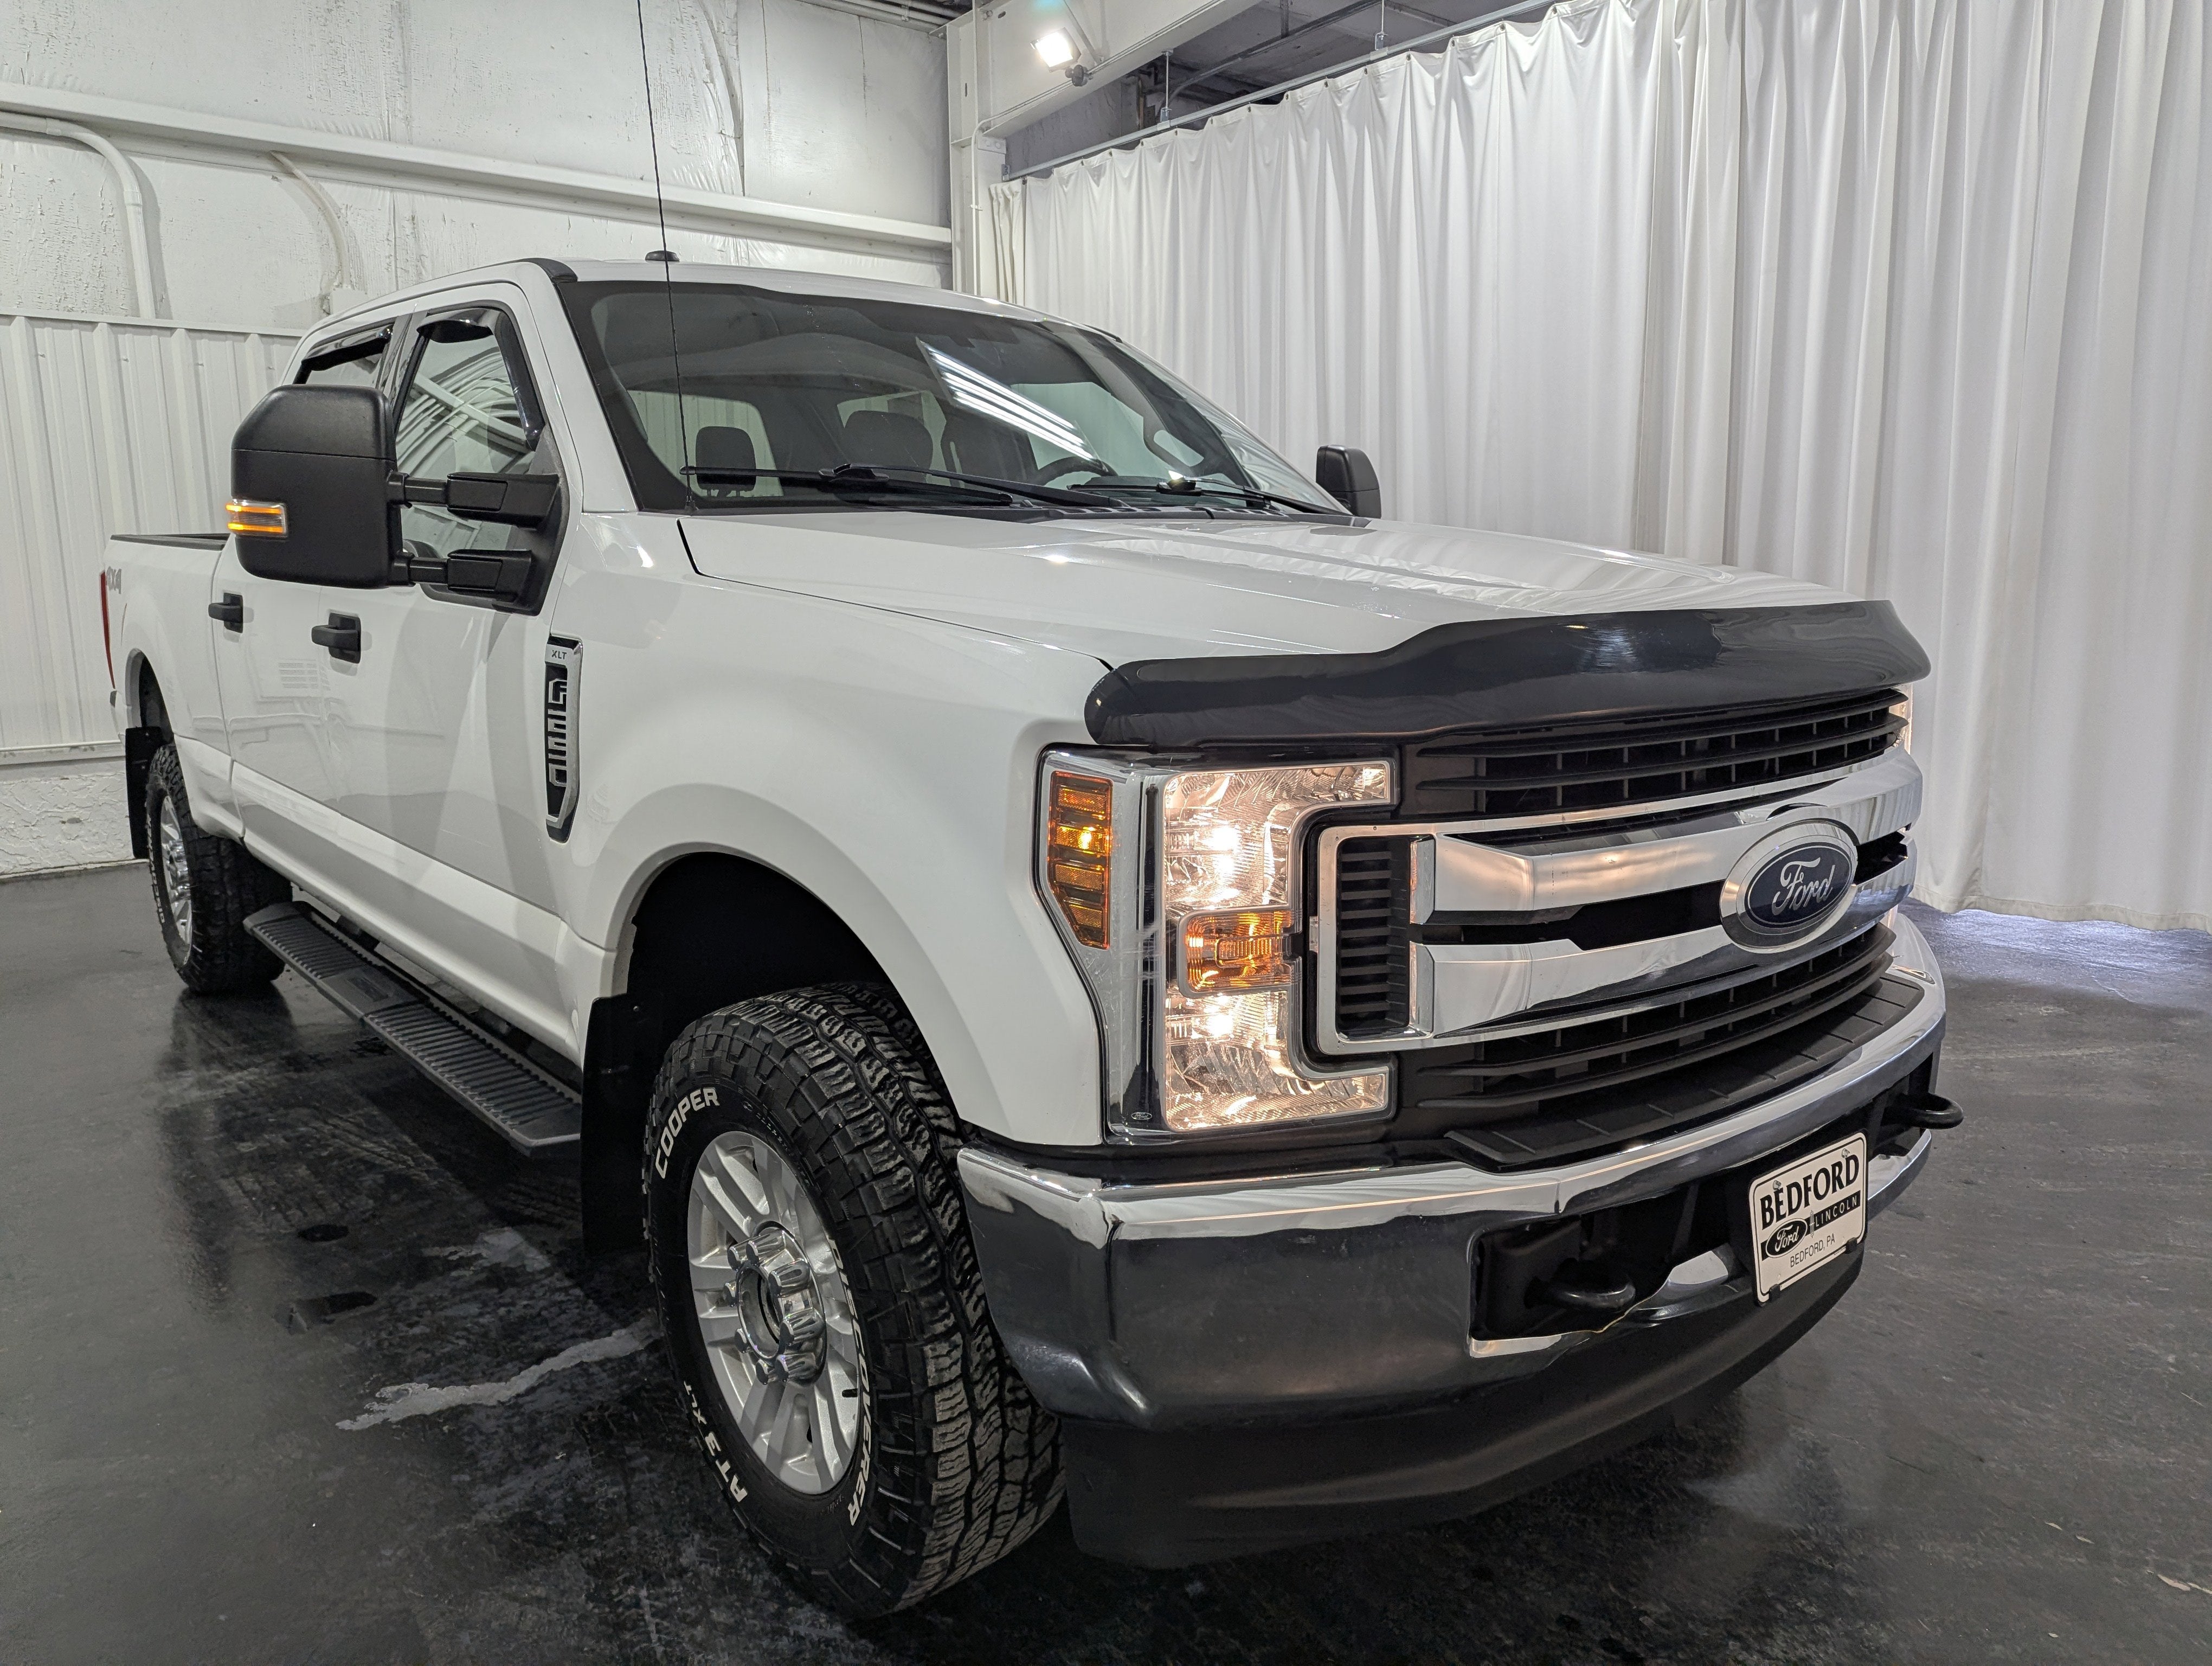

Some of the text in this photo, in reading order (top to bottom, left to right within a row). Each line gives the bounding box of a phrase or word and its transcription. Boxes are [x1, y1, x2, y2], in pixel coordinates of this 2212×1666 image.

[551, 650, 567, 660] XLT
[1771, 857, 1836, 916] Ford
[655, 1087, 720, 1179] COOPER
[1760, 1154, 1860, 1231] BEDFORD
[1815, 1195, 1857, 1227] LINCOLN
[1774, 1225, 1799, 1252] Ford
[1790, 1239, 1825, 1268] BEDFORD,
[1827, 1233, 1835, 1247] PA
[827, 1239, 871, 1526] DISCOVERER
[683, 1380, 748, 1503] AT3 XLT
